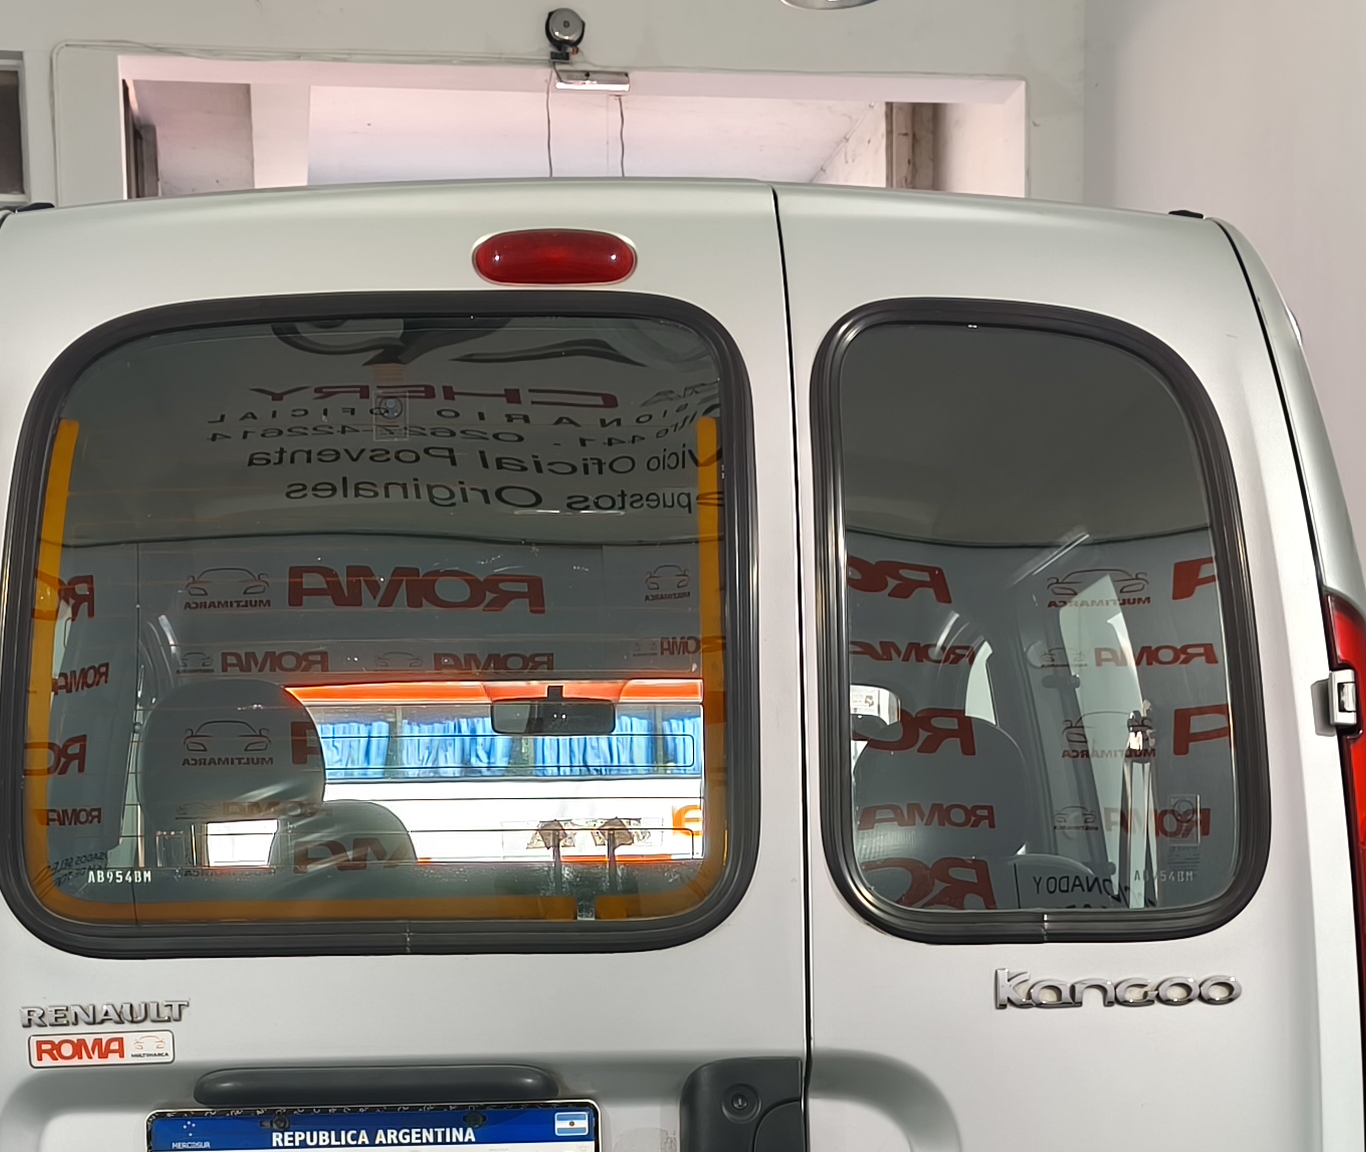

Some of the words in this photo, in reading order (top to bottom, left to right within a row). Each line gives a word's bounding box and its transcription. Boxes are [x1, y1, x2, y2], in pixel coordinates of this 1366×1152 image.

[87, 869, 153, 884] AB954BM
[20, 1000, 190, 1029] RENAULT
[35, 1037, 125, 1062] ROMA
[272, 1129, 369, 1148] REPUBLICA
[375, 1127, 476, 1144] ARGENTINA
